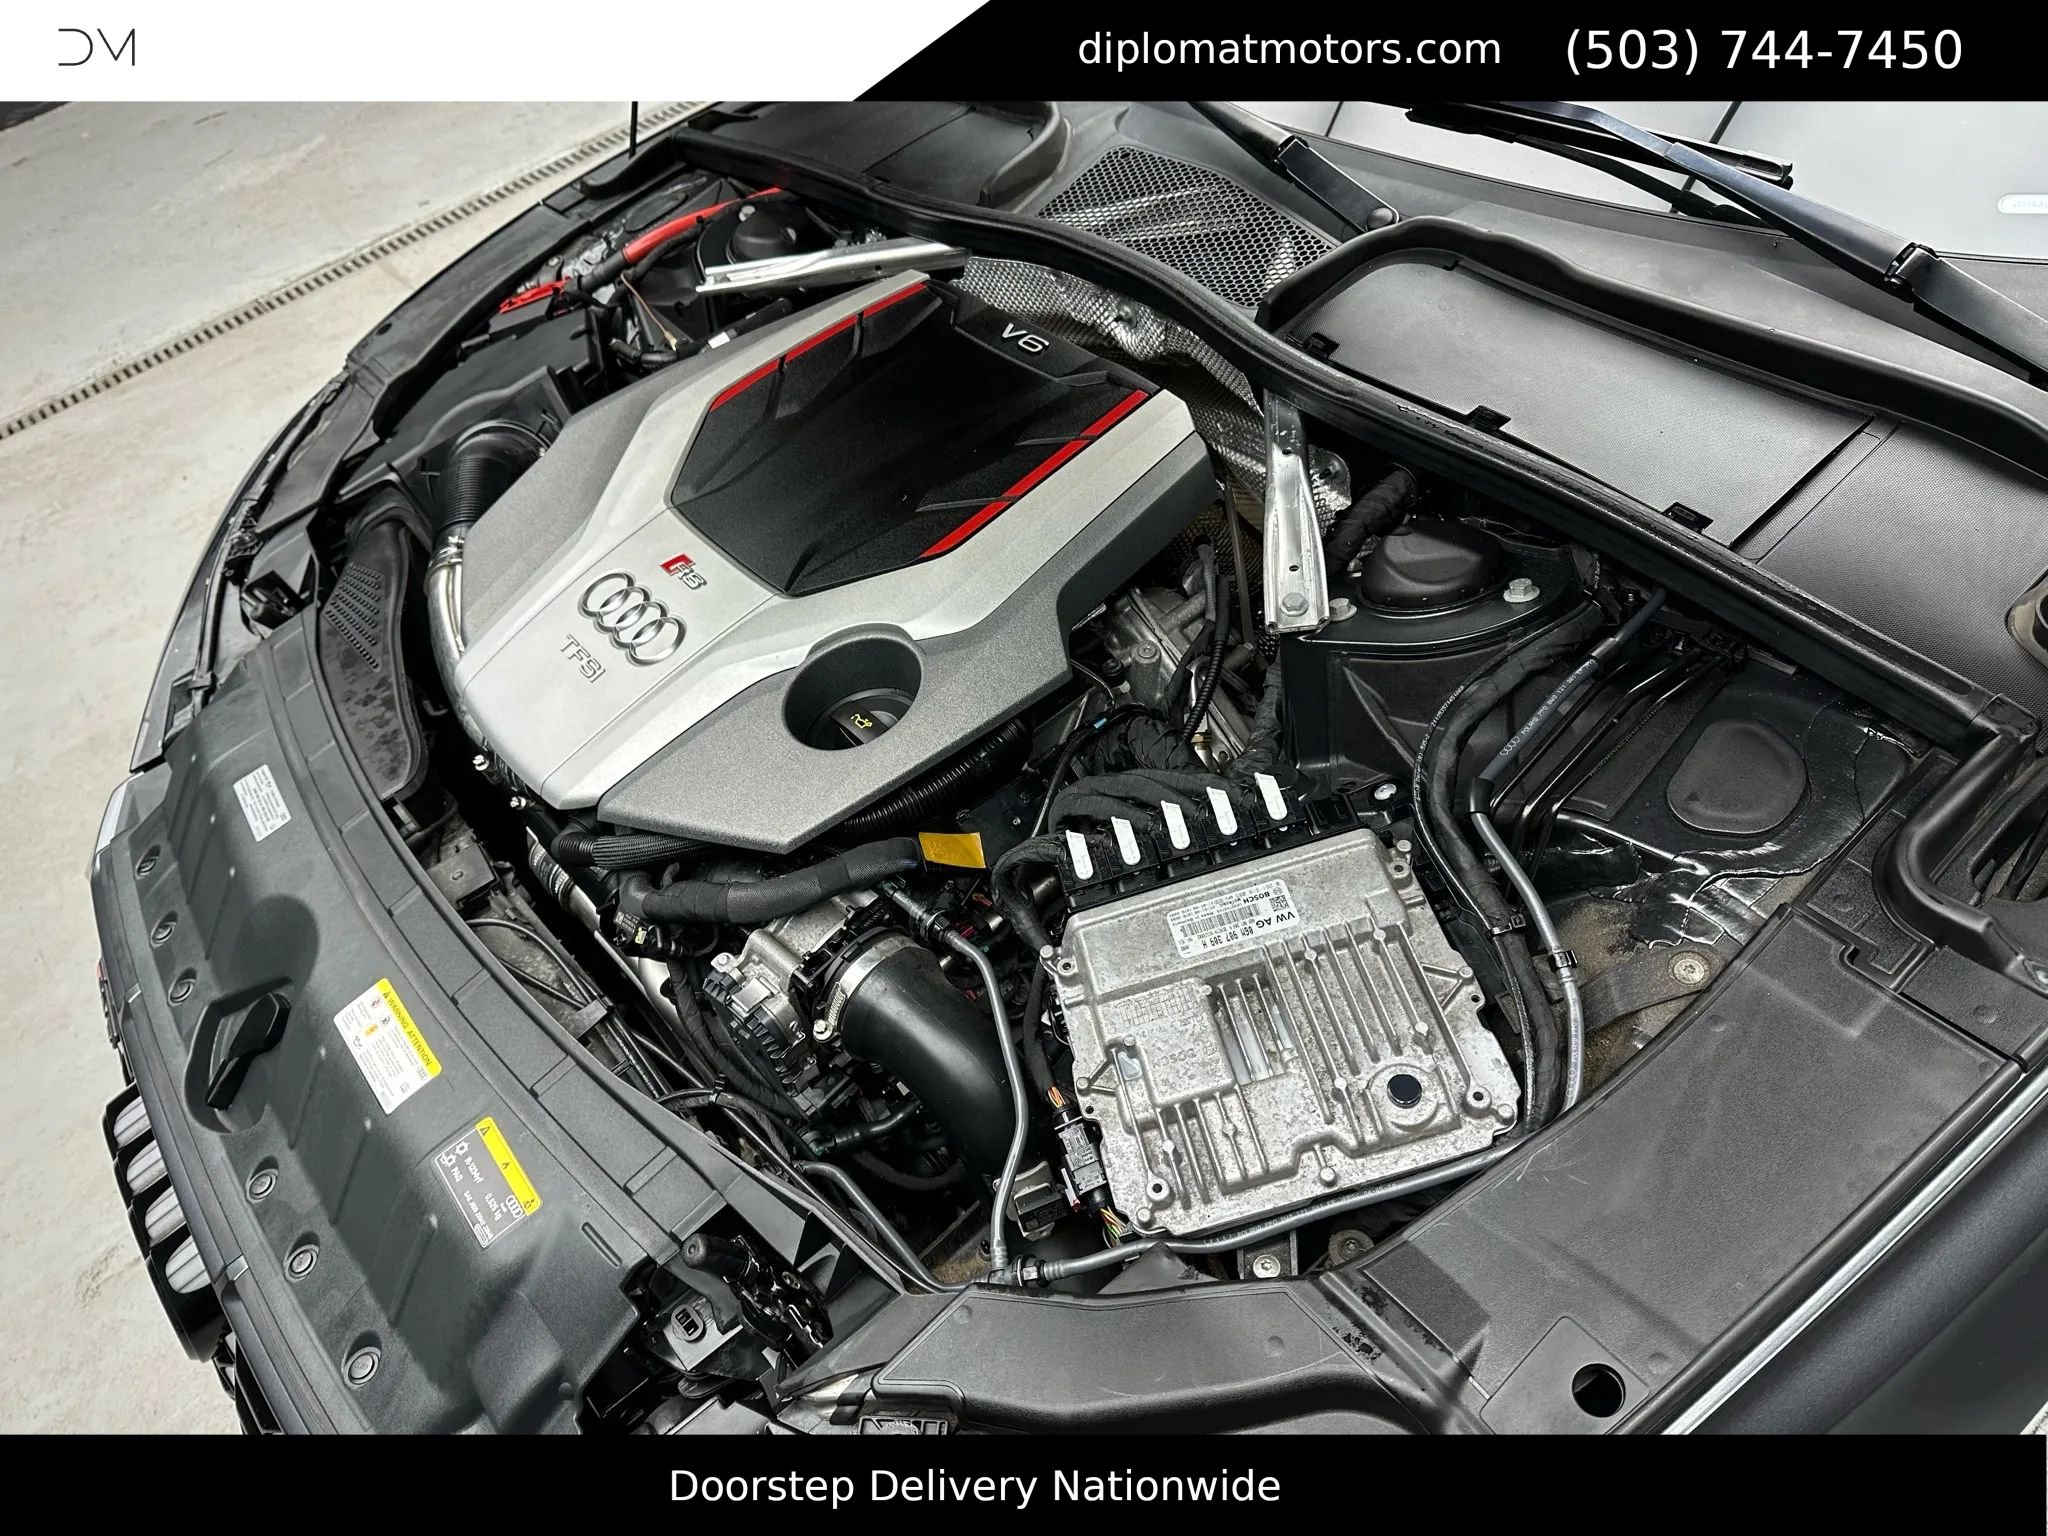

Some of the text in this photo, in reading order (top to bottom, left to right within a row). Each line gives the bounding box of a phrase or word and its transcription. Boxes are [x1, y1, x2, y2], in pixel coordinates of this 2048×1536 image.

[1002, 322, 1050, 352] V6
[659, 553, 707, 590] RS
[560, 633, 606, 683] TFSI
[1242, 890, 1270, 904] BOSCH
[1254, 916, 1273, 929] AG
[1274, 910, 1295, 923] VW
[1224, 930, 1238, 942] 907
[386, 996, 410, 1029] WARNING
[406, 1028, 432, 1067] ATTENTION
[449, 1165, 464, 1183] PAG
